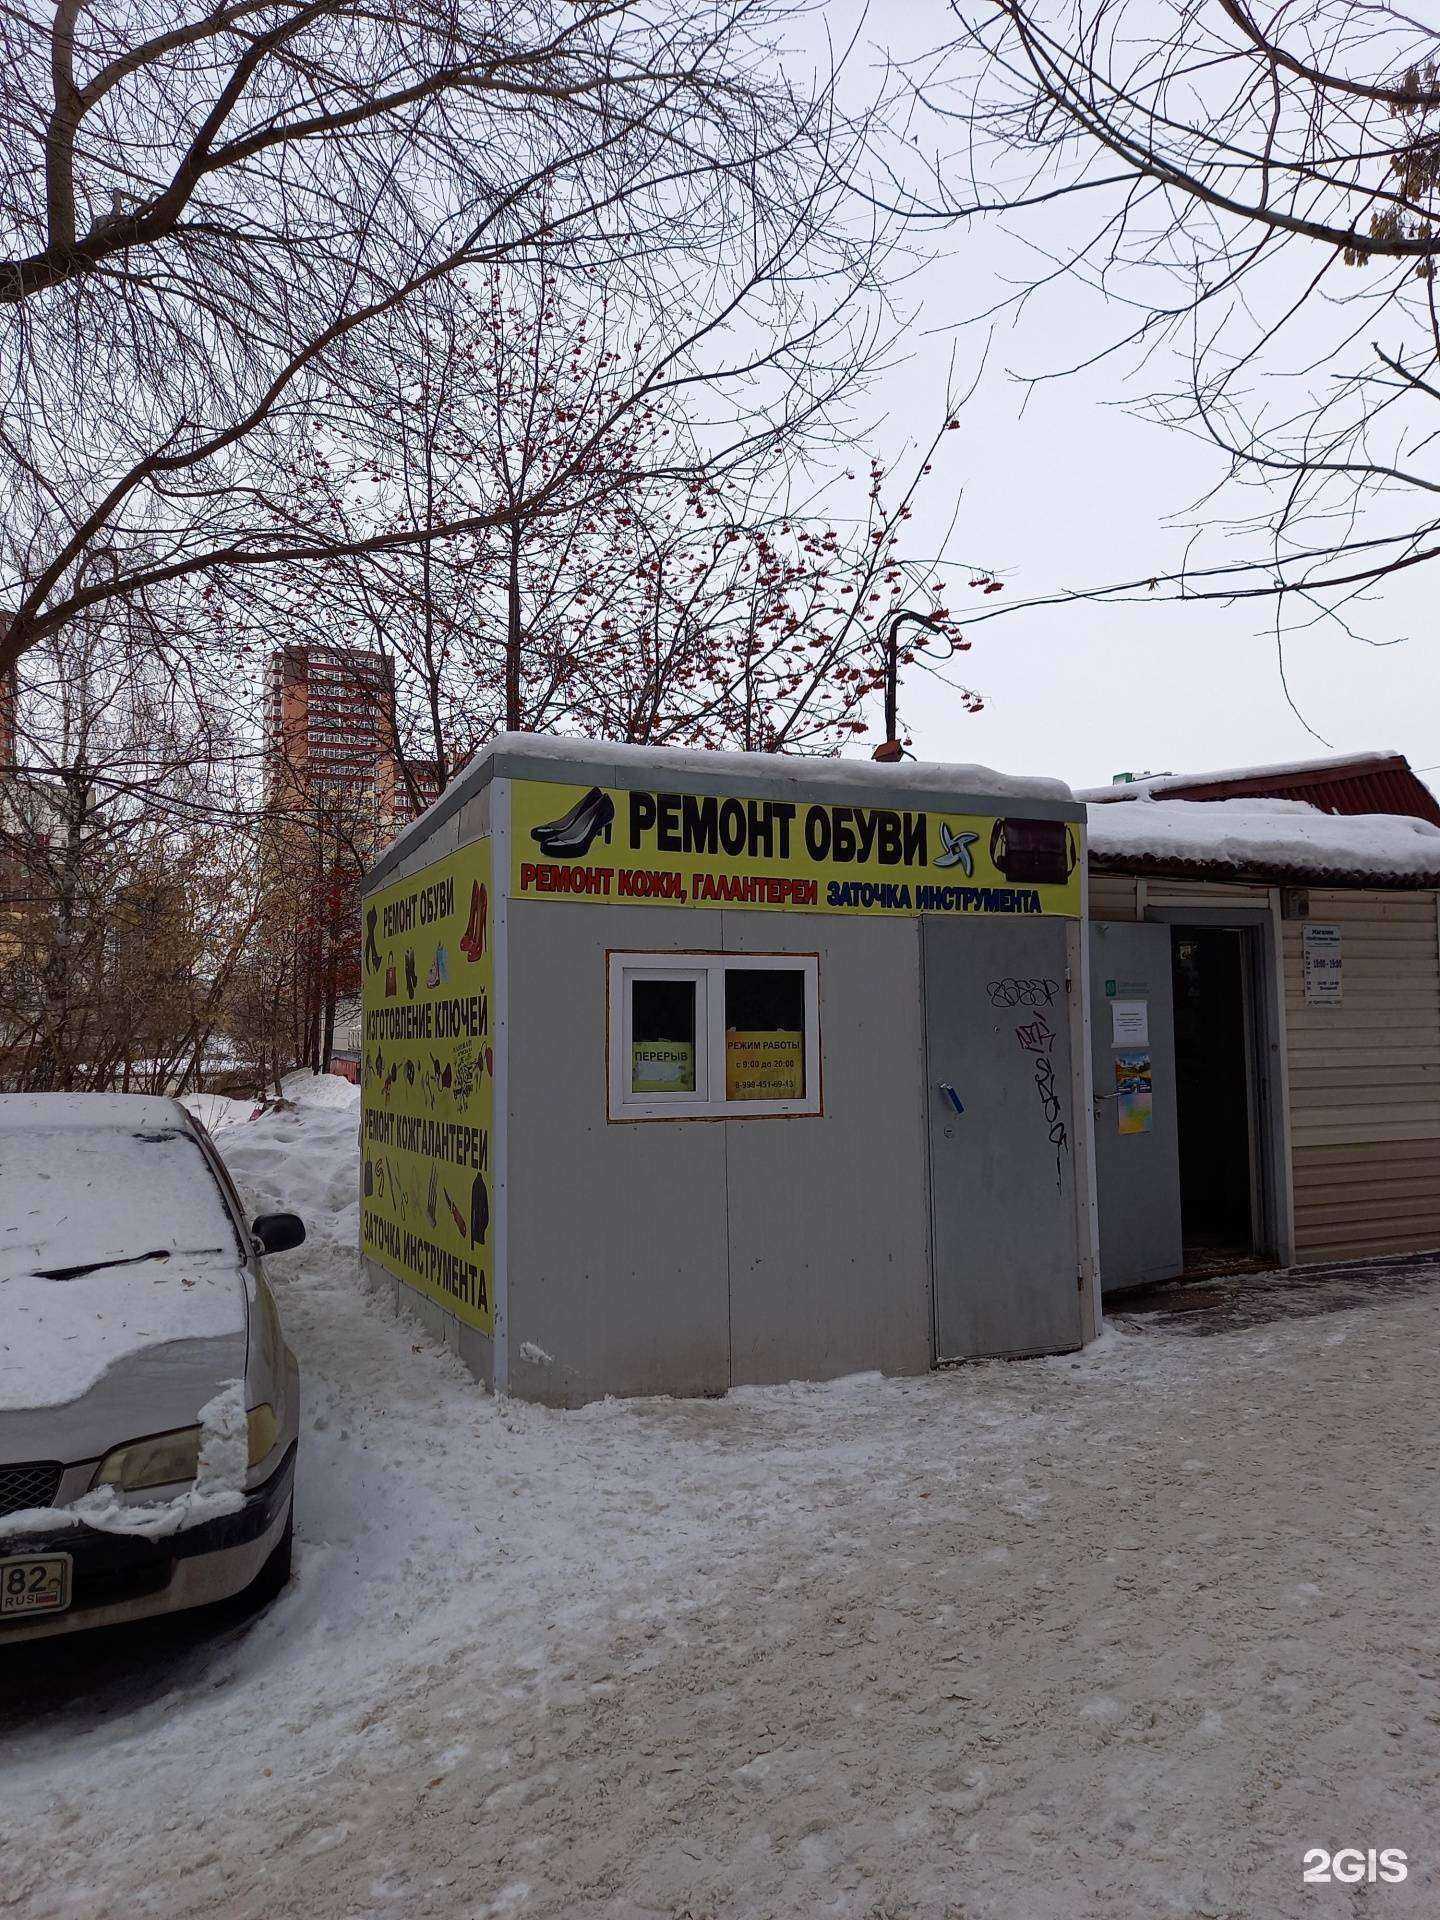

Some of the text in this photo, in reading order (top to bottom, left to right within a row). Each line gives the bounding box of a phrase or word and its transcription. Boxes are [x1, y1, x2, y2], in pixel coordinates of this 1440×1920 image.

[629, 790, 928, 867] РЕМОНТ ОБУВИ
[383, 876, 454, 939] РЕМОНТ ОБУВИ
[521, 862, 1042, 914] РЕМОНТ КОЖИ, ГАЛАНТЕРЕИ ЗАТОЧКА ИНСТРУМЕНТА
[366, 985, 488, 1041] ИЗГОТОВЛЕНИЕ КЛЮЧЕЙ
[635, 1051, 688, 1062] ПЕРЕРЫВ
[728, 1041, 800, 1050] РЕЖИМ РАБОТЫ
[761, 1061, 772, 1070] до
[364, 1107, 488, 1172] РЕМОНТ КОЖГАЛАНТЕРЕИ
[364, 1209, 488, 1314] ЗАТОЧКА ИНСТРУМЕНТА
[5, 1594, 36, 1608] RUS
[7, 1566, 47, 1595] 82
